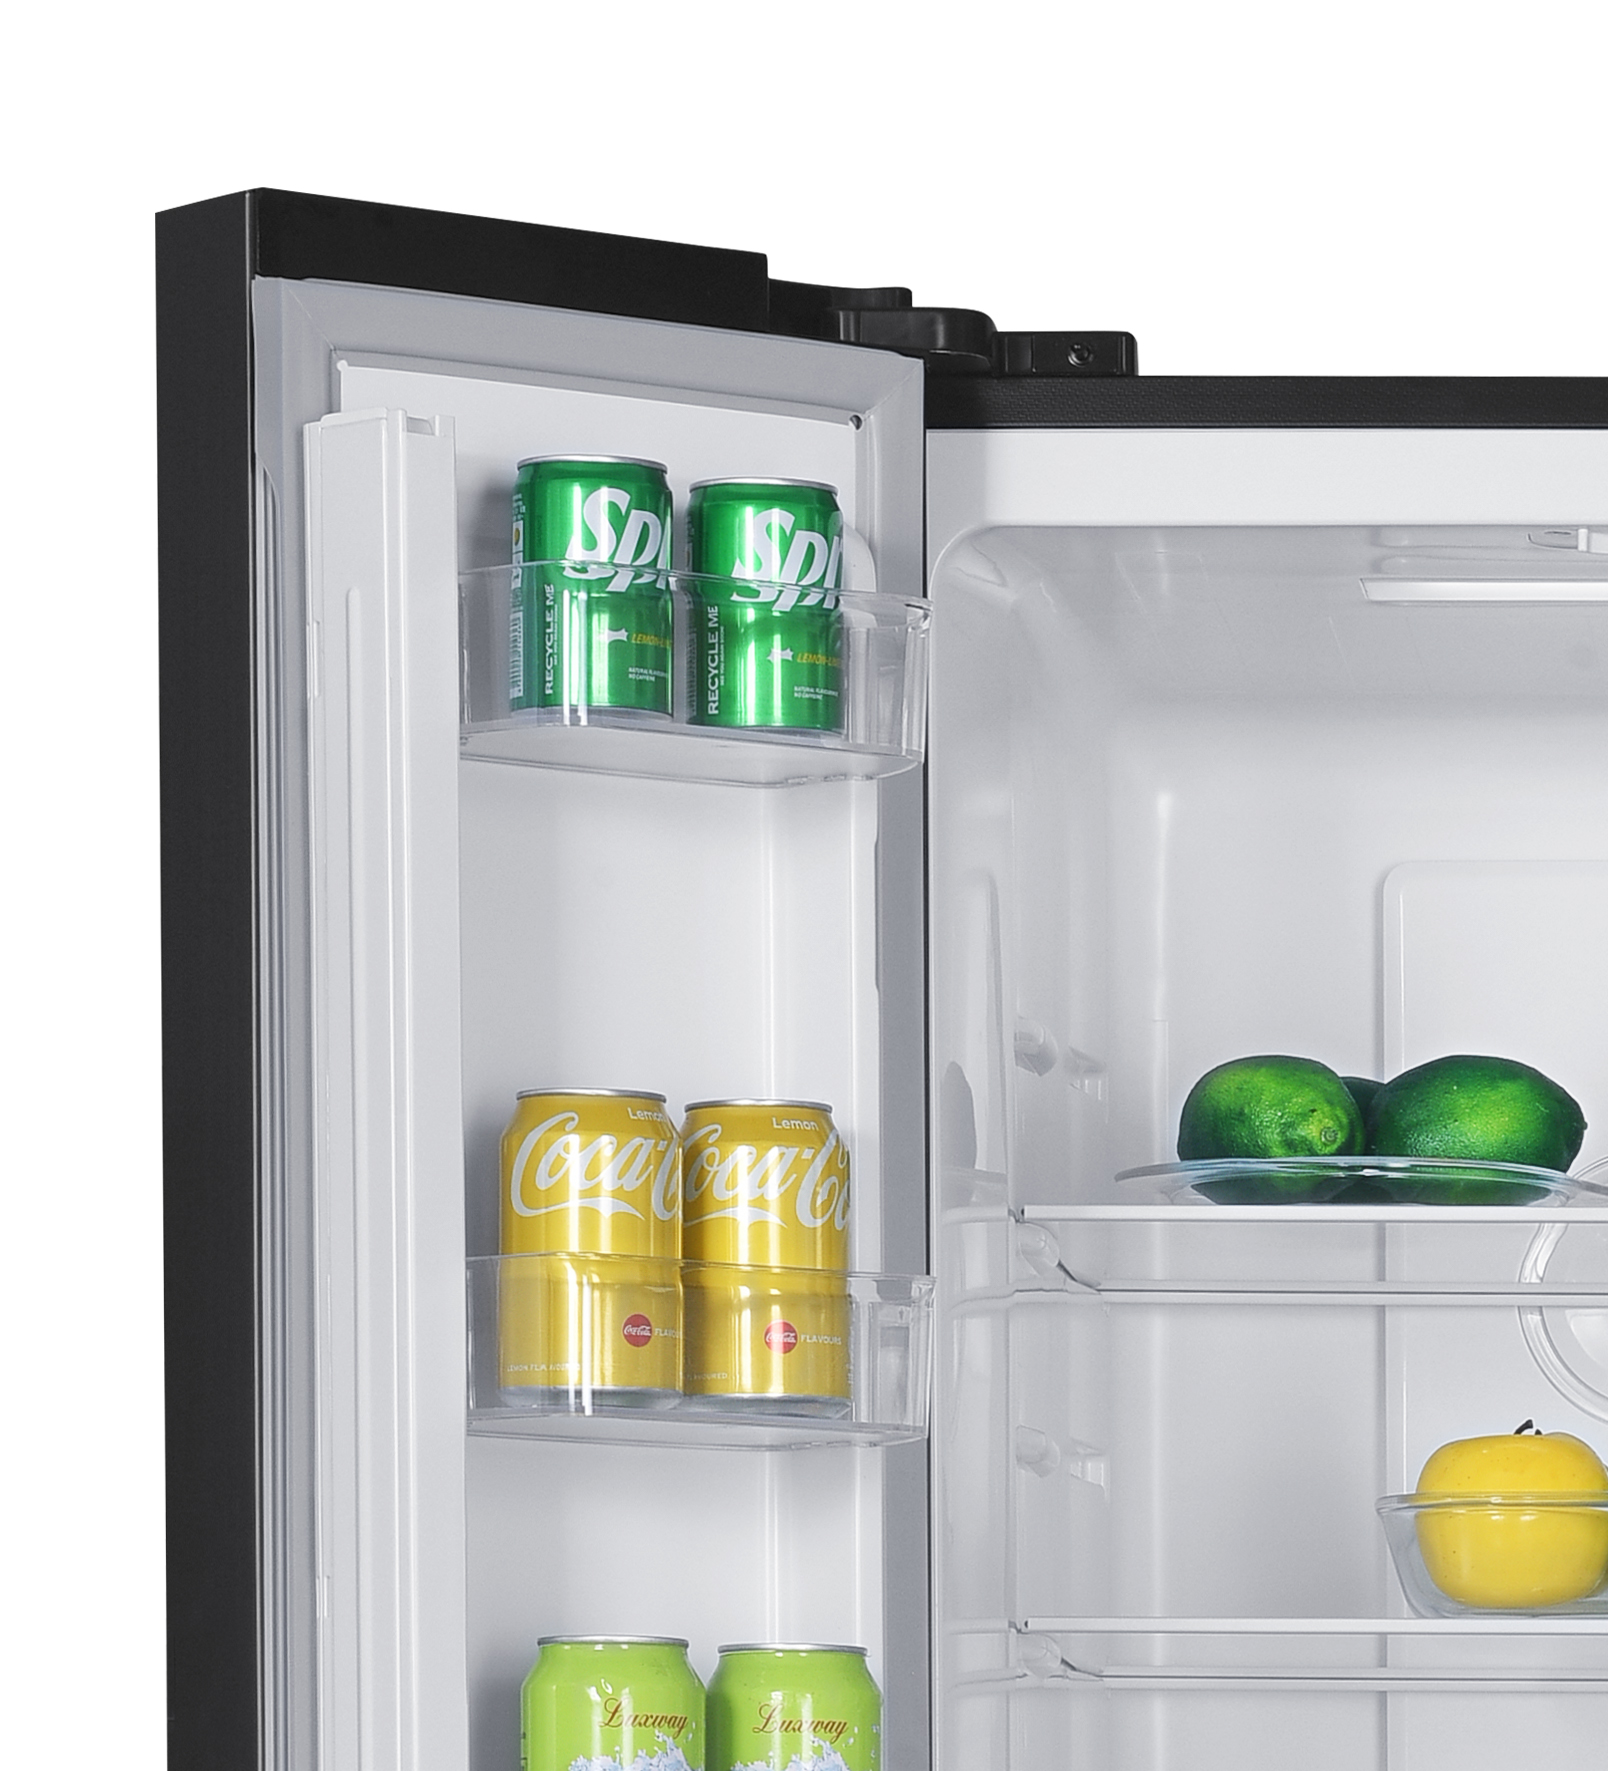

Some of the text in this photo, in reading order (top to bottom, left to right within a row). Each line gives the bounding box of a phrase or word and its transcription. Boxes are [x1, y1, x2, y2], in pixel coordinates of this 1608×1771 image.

[544, 584, 554, 695] RECYCLE ME
[708, 605, 719, 715] RECYCLE ME
[772, 1116, 820, 1131] Lemon
[801, 1334, 842, 1346] FLAVOURS
[599, 1697, 689, 1740] Luxway
[752, 1703, 850, 1745] Luxway
